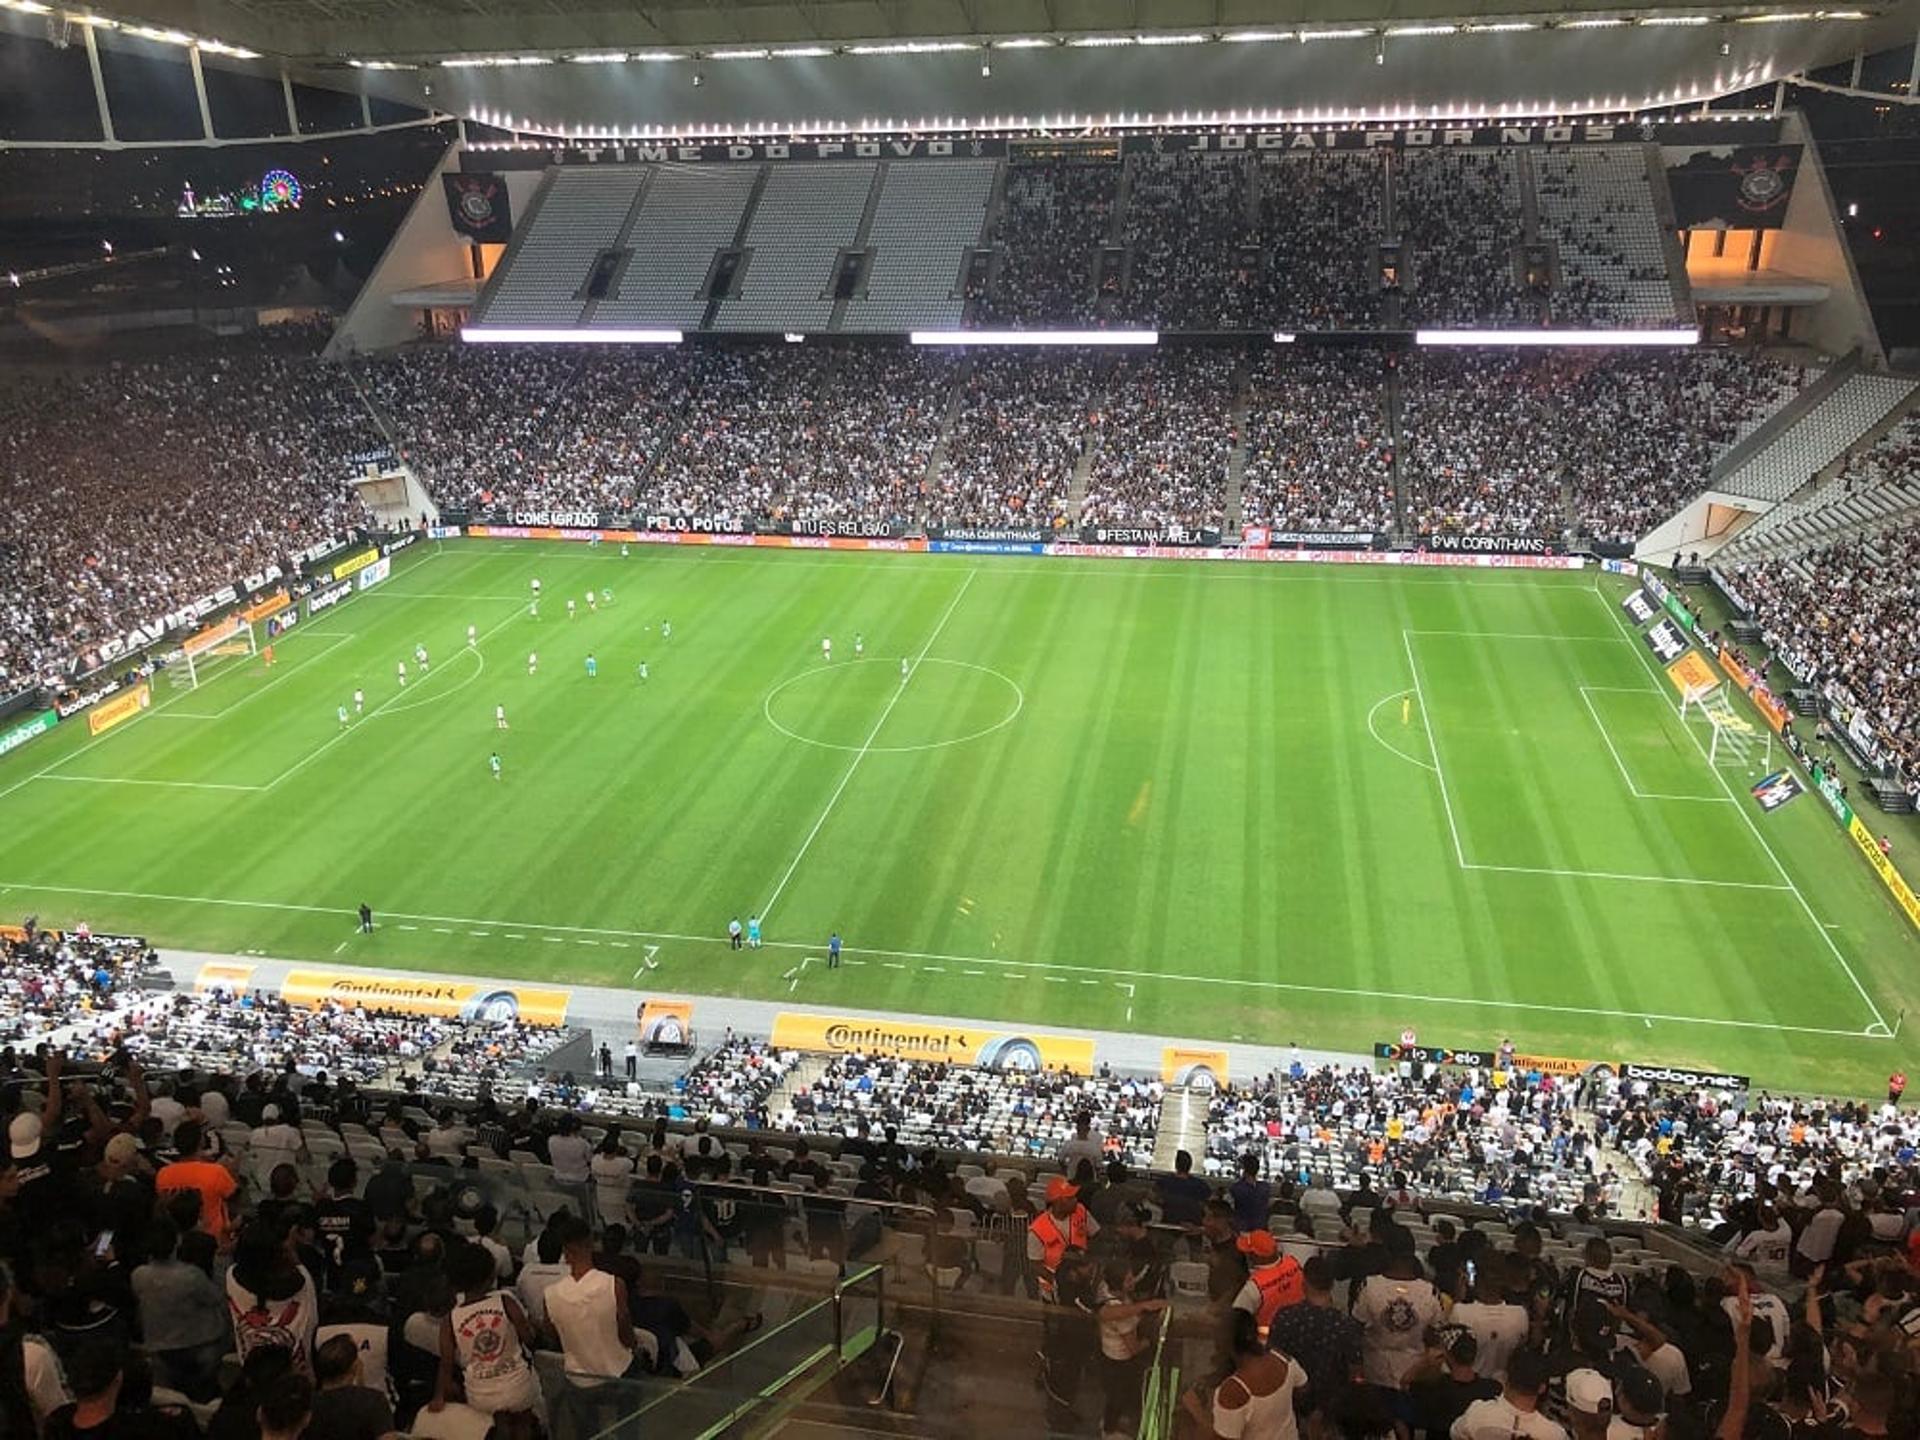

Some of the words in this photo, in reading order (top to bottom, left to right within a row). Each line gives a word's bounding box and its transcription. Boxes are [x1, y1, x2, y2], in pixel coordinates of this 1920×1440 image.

[1188, 132, 1336, 151] JOGAI
[1365, 129, 1474, 147] POR
[580, 146, 702, 162] TIME
[729, 145, 789, 160] DO
[818, 141, 953, 158] POVO
[976, 529, 1042, 541] CORINTHIANS
[825, 1024, 950, 1052] Continental
[1454, 1052, 1480, 1067] elo
[1626, 1064, 1740, 1088] bodog.net
